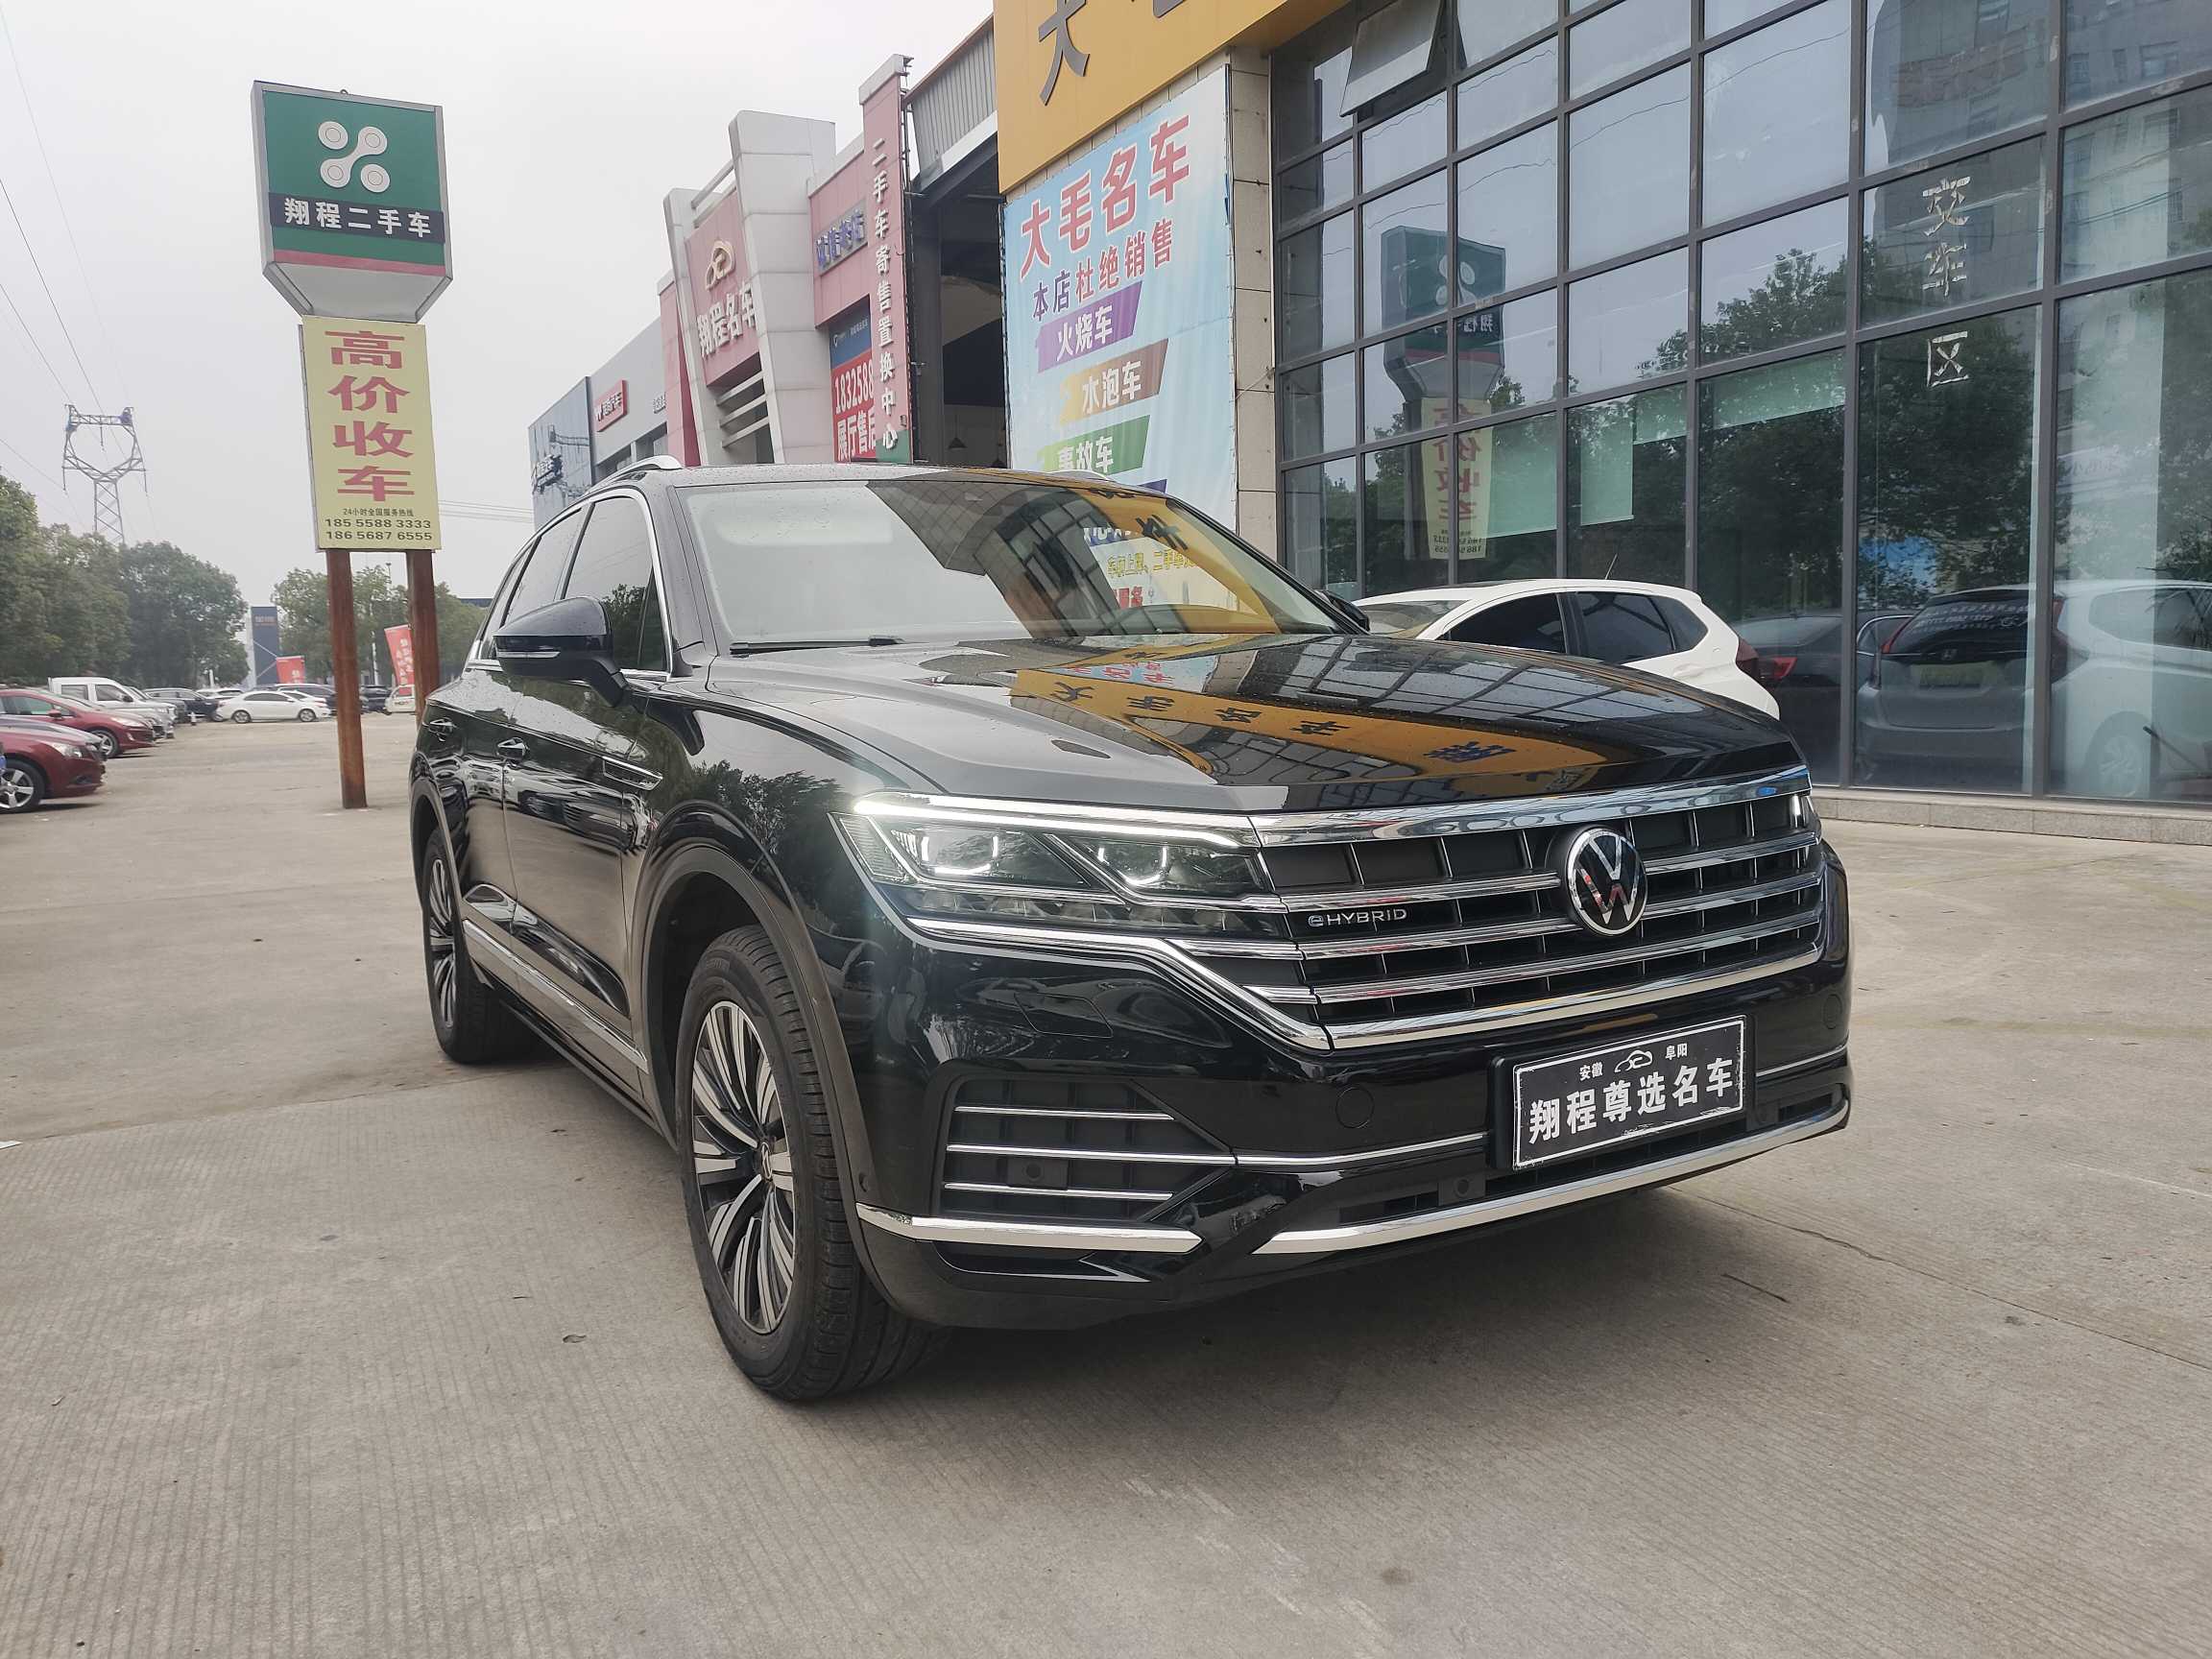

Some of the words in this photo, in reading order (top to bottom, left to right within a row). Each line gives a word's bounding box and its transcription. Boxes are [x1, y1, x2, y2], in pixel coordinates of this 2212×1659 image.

[284, 198, 431, 237] 翔程二手车
[1021, 115, 1190, 282] 大毛名车
[872, 137, 898, 450] 二手车寄售置换中心
[1033, 218, 1172, 322] 本店杜绝销售
[697, 281, 757, 358] 翔程名车
[1056, 305, 1113, 361] 火烧车
[1082, 360, 1142, 414] 水泡车
[325, 330, 415, 502] 高价收车
[1056, 437, 1114, 473] 事故车
[325, 518, 351, 527] 185
[355, 518, 393, 527] 5588
[396, 519, 431, 528] 3333
[325, 531, 352, 540] 186
[356, 531, 392, 540] 5687
[397, 532, 432, 541] 6555
[1308, 908, 1408, 927] eHYBRID
[1578, 1062, 1603, 1081] 安徽
[1665, 1043, 1688, 1061] 阜阳
[1528, 1057, 1734, 1144] 翔程尊选名车
